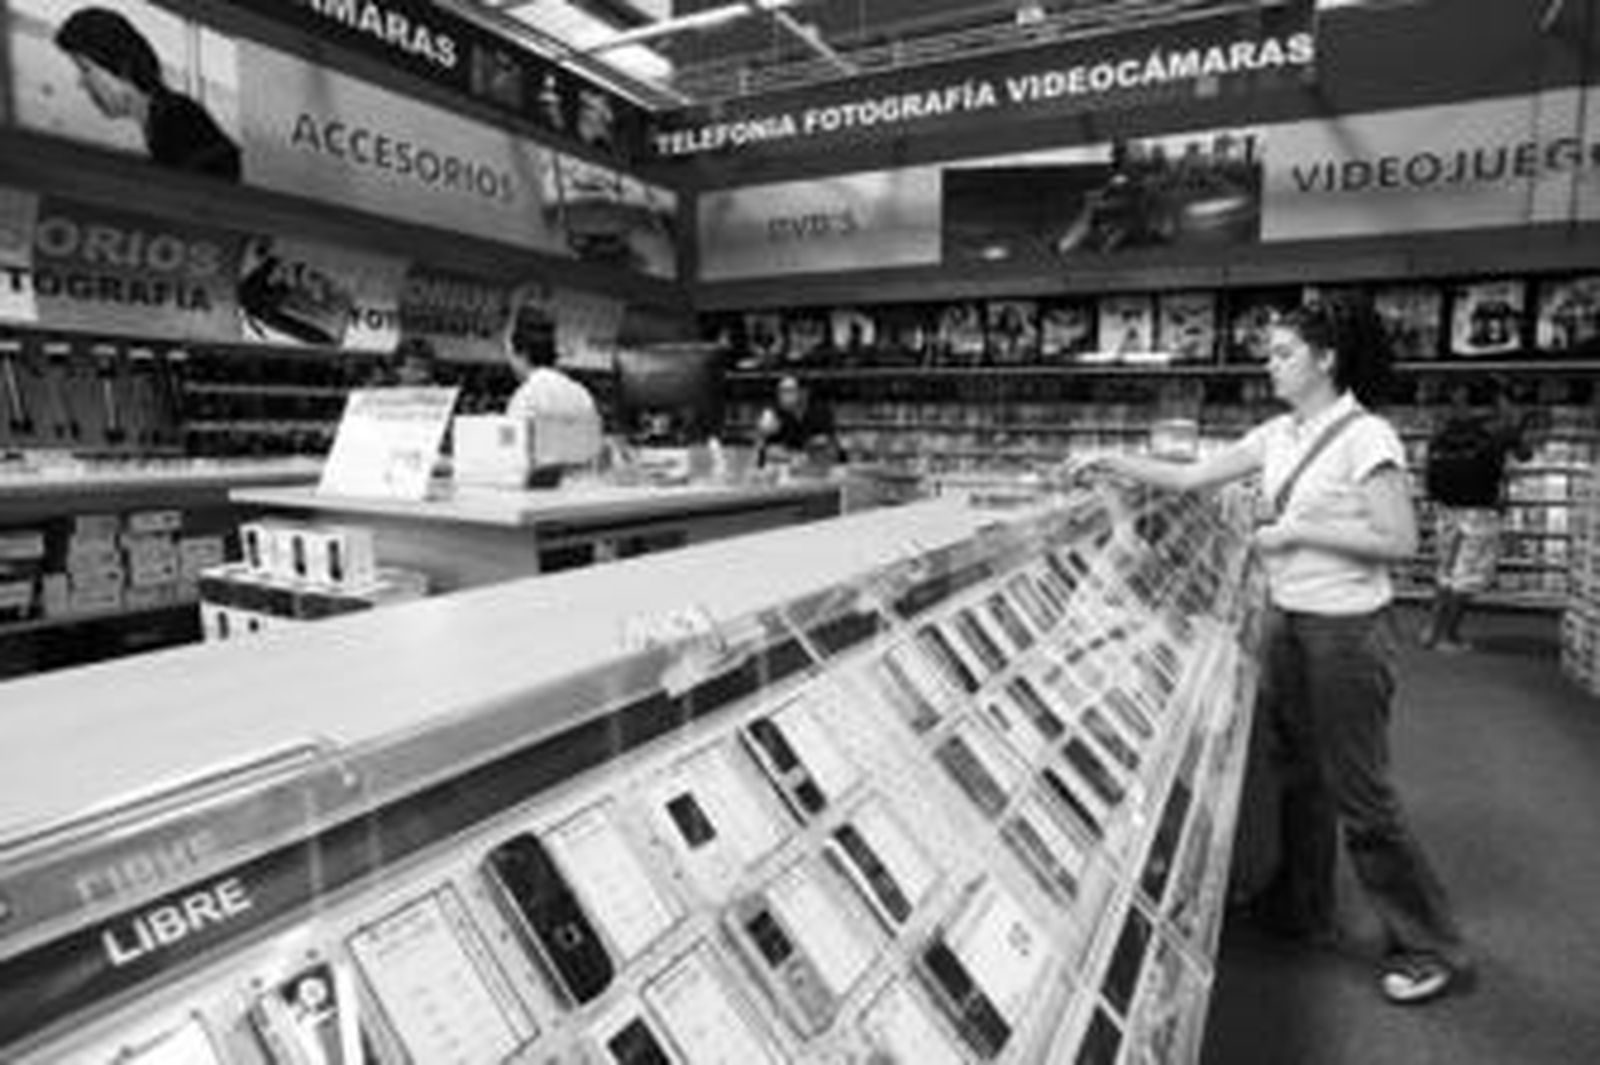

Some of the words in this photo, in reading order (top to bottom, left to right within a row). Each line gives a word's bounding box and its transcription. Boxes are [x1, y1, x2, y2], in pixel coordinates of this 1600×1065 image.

[310, 0, 457, 68] MARAS
[1005, 32, 1316, 101] VIDEOCÁMARAS
[102, 878, 251, 967] LIBRE
